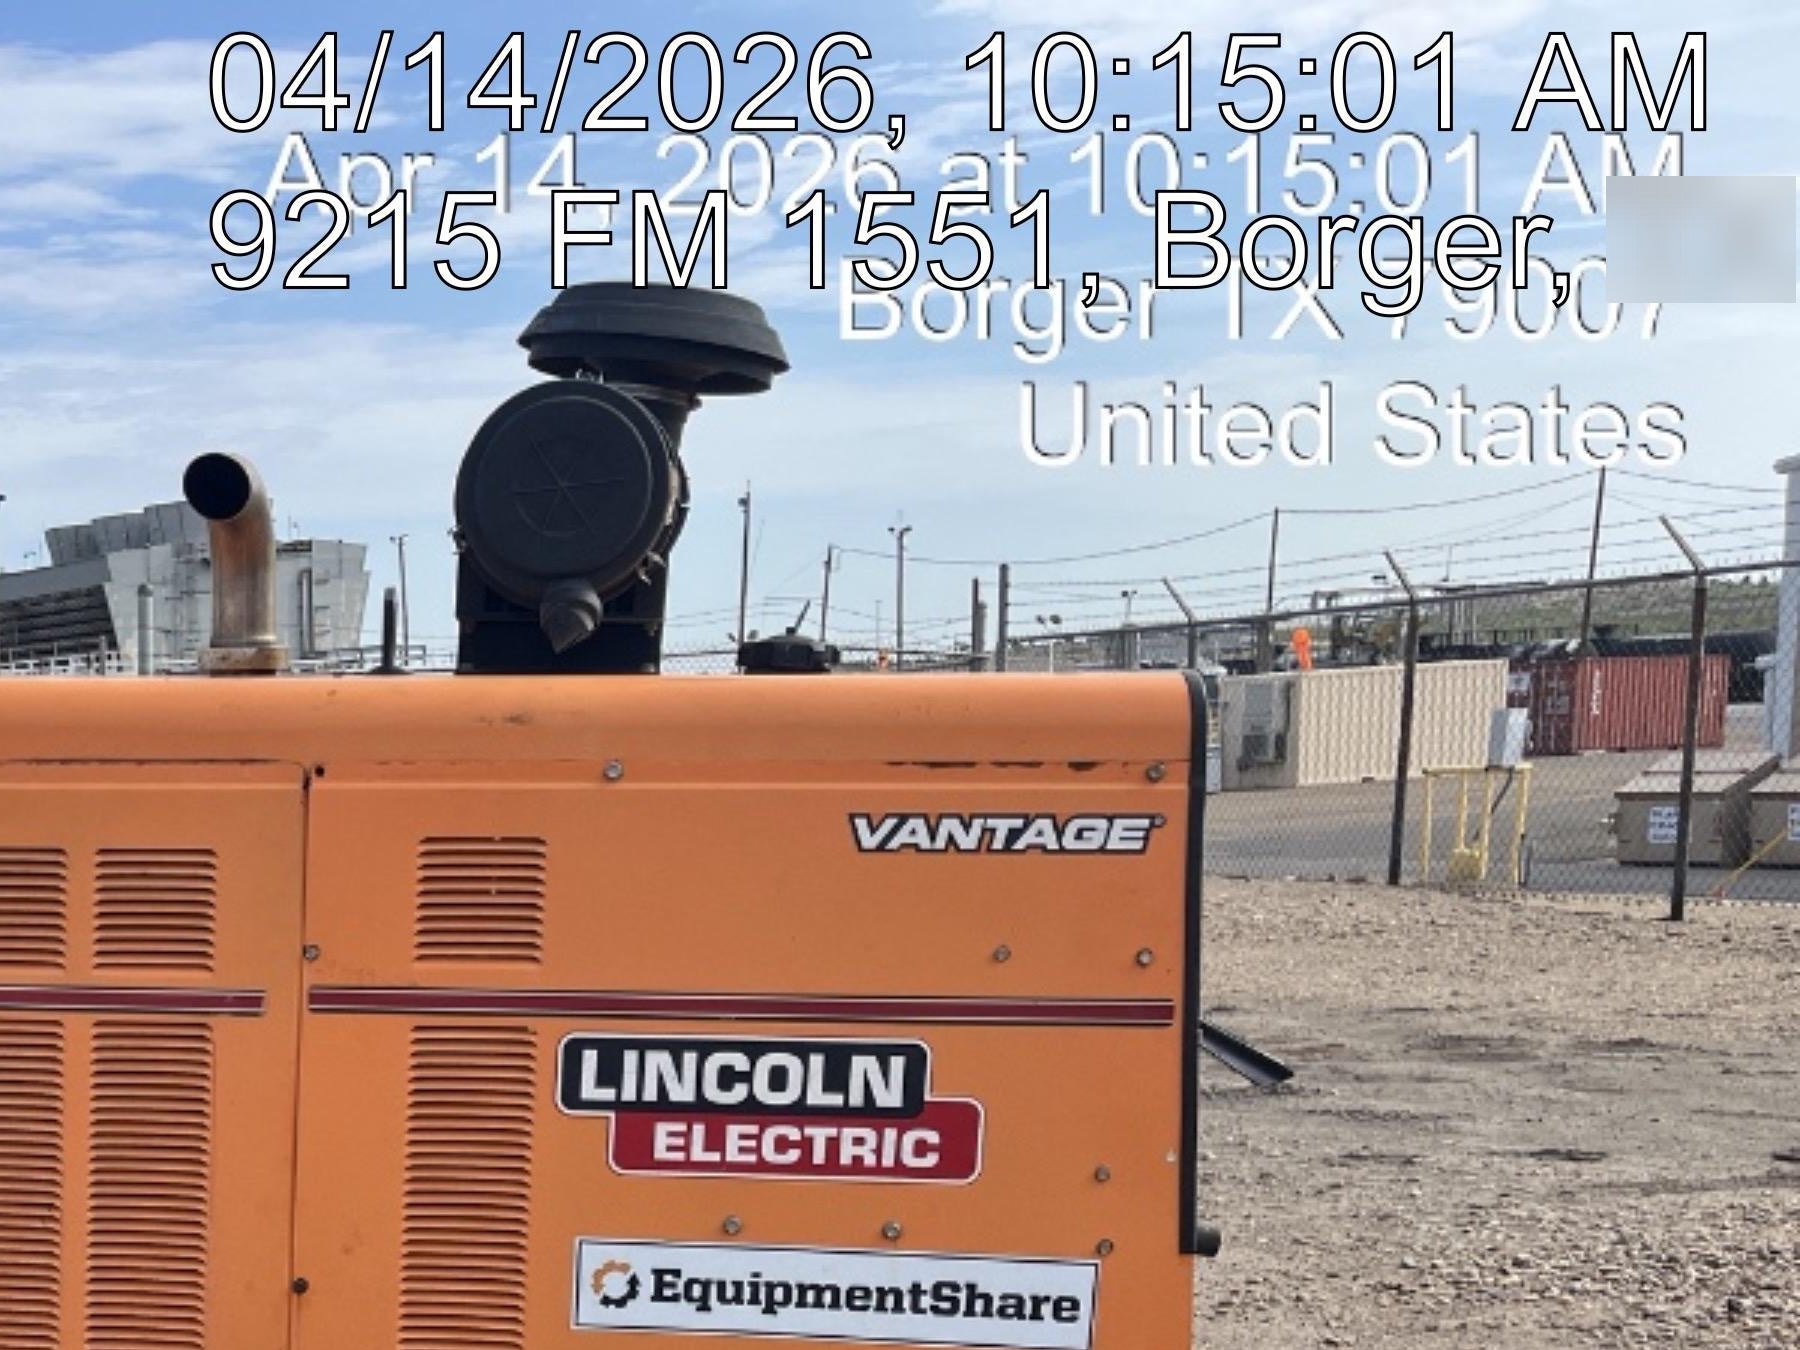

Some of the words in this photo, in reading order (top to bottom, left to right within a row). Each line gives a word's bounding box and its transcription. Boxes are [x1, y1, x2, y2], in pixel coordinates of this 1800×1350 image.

[851, 814, 1153, 852] VANTAGE
[579, 1048, 908, 1109] LINCOLN
[652, 1121, 941, 1170] ELECTRIC
[649, 1267, 1081, 1325] EquipmentShare
